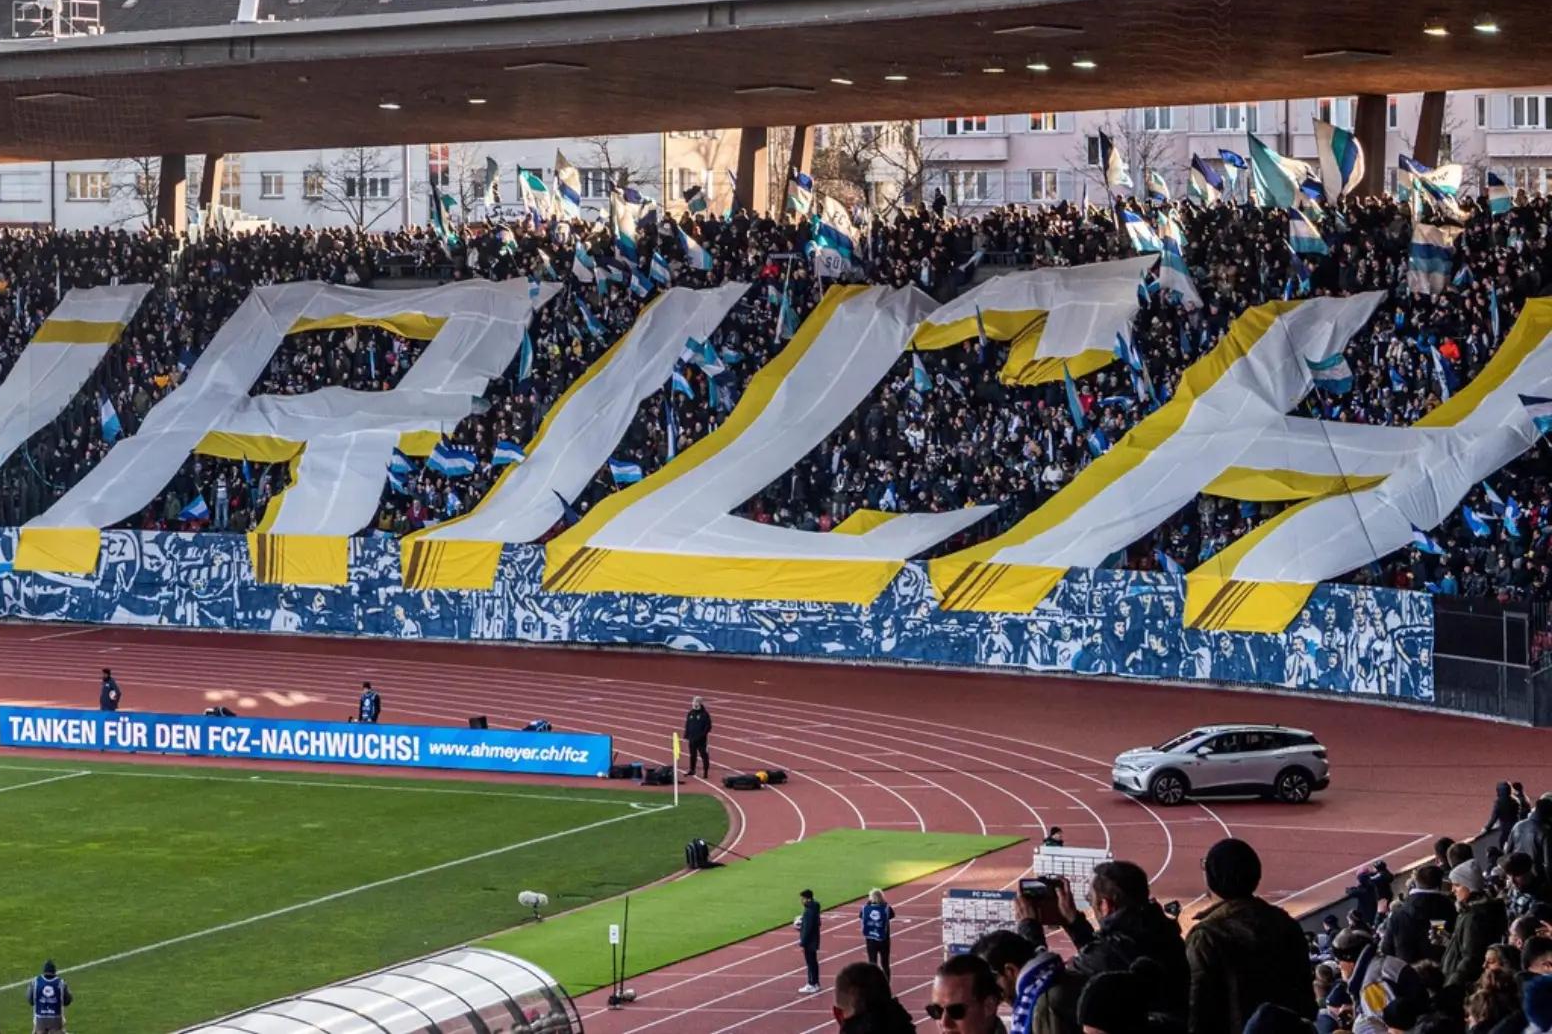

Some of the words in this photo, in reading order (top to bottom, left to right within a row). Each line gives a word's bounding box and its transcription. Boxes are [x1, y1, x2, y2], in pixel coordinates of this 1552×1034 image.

[9, 716, 97, 744] TANKEN
[104, 717, 147, 747] FÜR
[155, 724, 201, 751] DEN
[209, 727, 420, 762] FCZ-NACHWUCHS!
[429, 740, 589, 763] www.ahmeyer.ch/fcz
